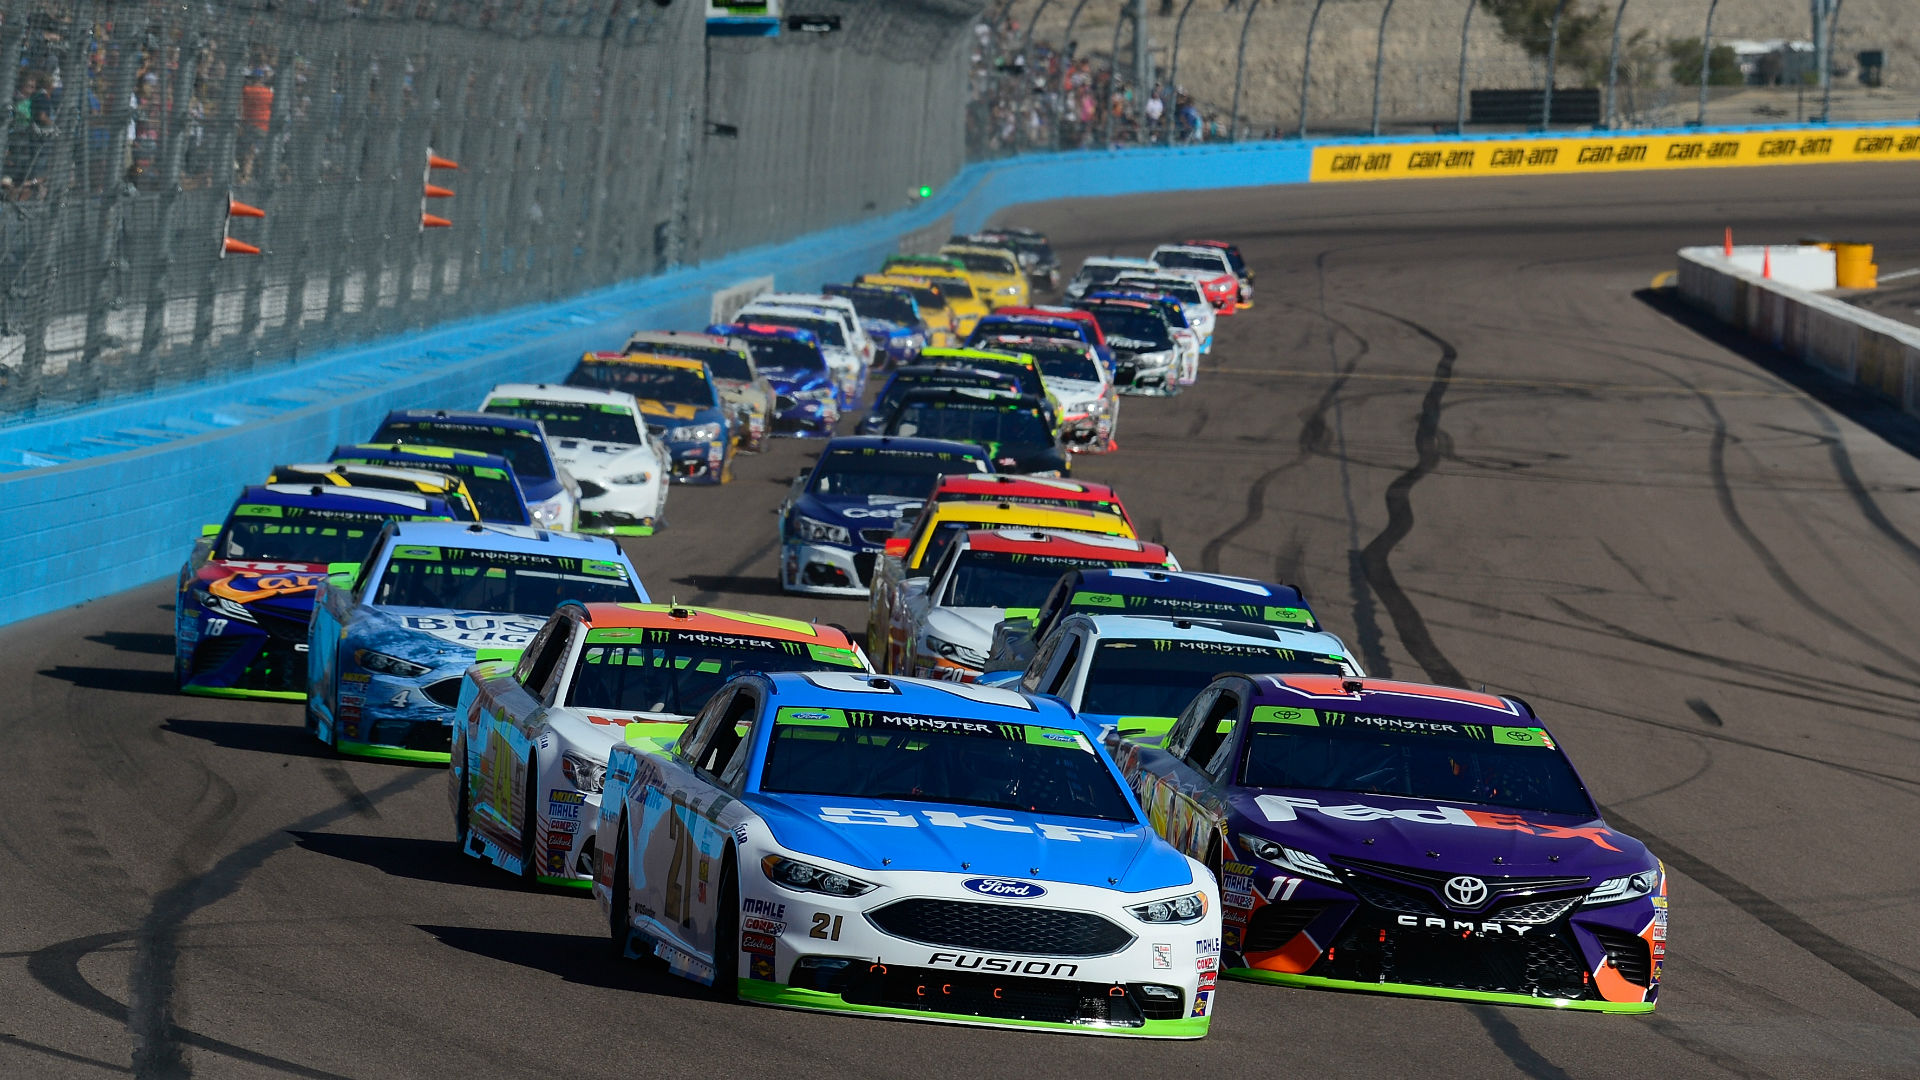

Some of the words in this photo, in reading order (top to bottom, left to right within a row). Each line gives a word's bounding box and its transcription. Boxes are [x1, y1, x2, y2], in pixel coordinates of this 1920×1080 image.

[470, 551, 552, 564] MONSTER
[1033, 556, 1107, 567] MONSTER
[1154, 599, 1236, 612] MONSTER
[205, 618, 228, 636] 18
[678, 633, 775, 649] MONSTER
[1179, 642, 1270, 656] MONSTER
[942, 667, 965, 682] 20
[391, 689, 411, 708] 4
[883, 715, 993, 734] MONSTER
[1354, 716, 1458, 733] MONSTER
[552, 791, 585, 804] MOOG
[549, 803, 579, 818] MAHLE
[551, 820, 570, 831] COMP
[819, 807, 1138, 842] SKF
[1254, 794, 1623, 852] FedEx
[1224, 862, 1256, 876] MOOG
[979, 878, 1030, 896] Ford
[1224, 875, 1252, 894] MAHLE
[1268, 876, 1304, 900] 11
[743, 897, 786, 919] MAHLE
[745, 918, 774, 932] COMP
[809, 912, 844, 941] 21
[1398, 915, 1532, 935] CAMRY
[1196, 937, 1220, 954] MAHLE
[928, 952, 1078, 977] FUSION
